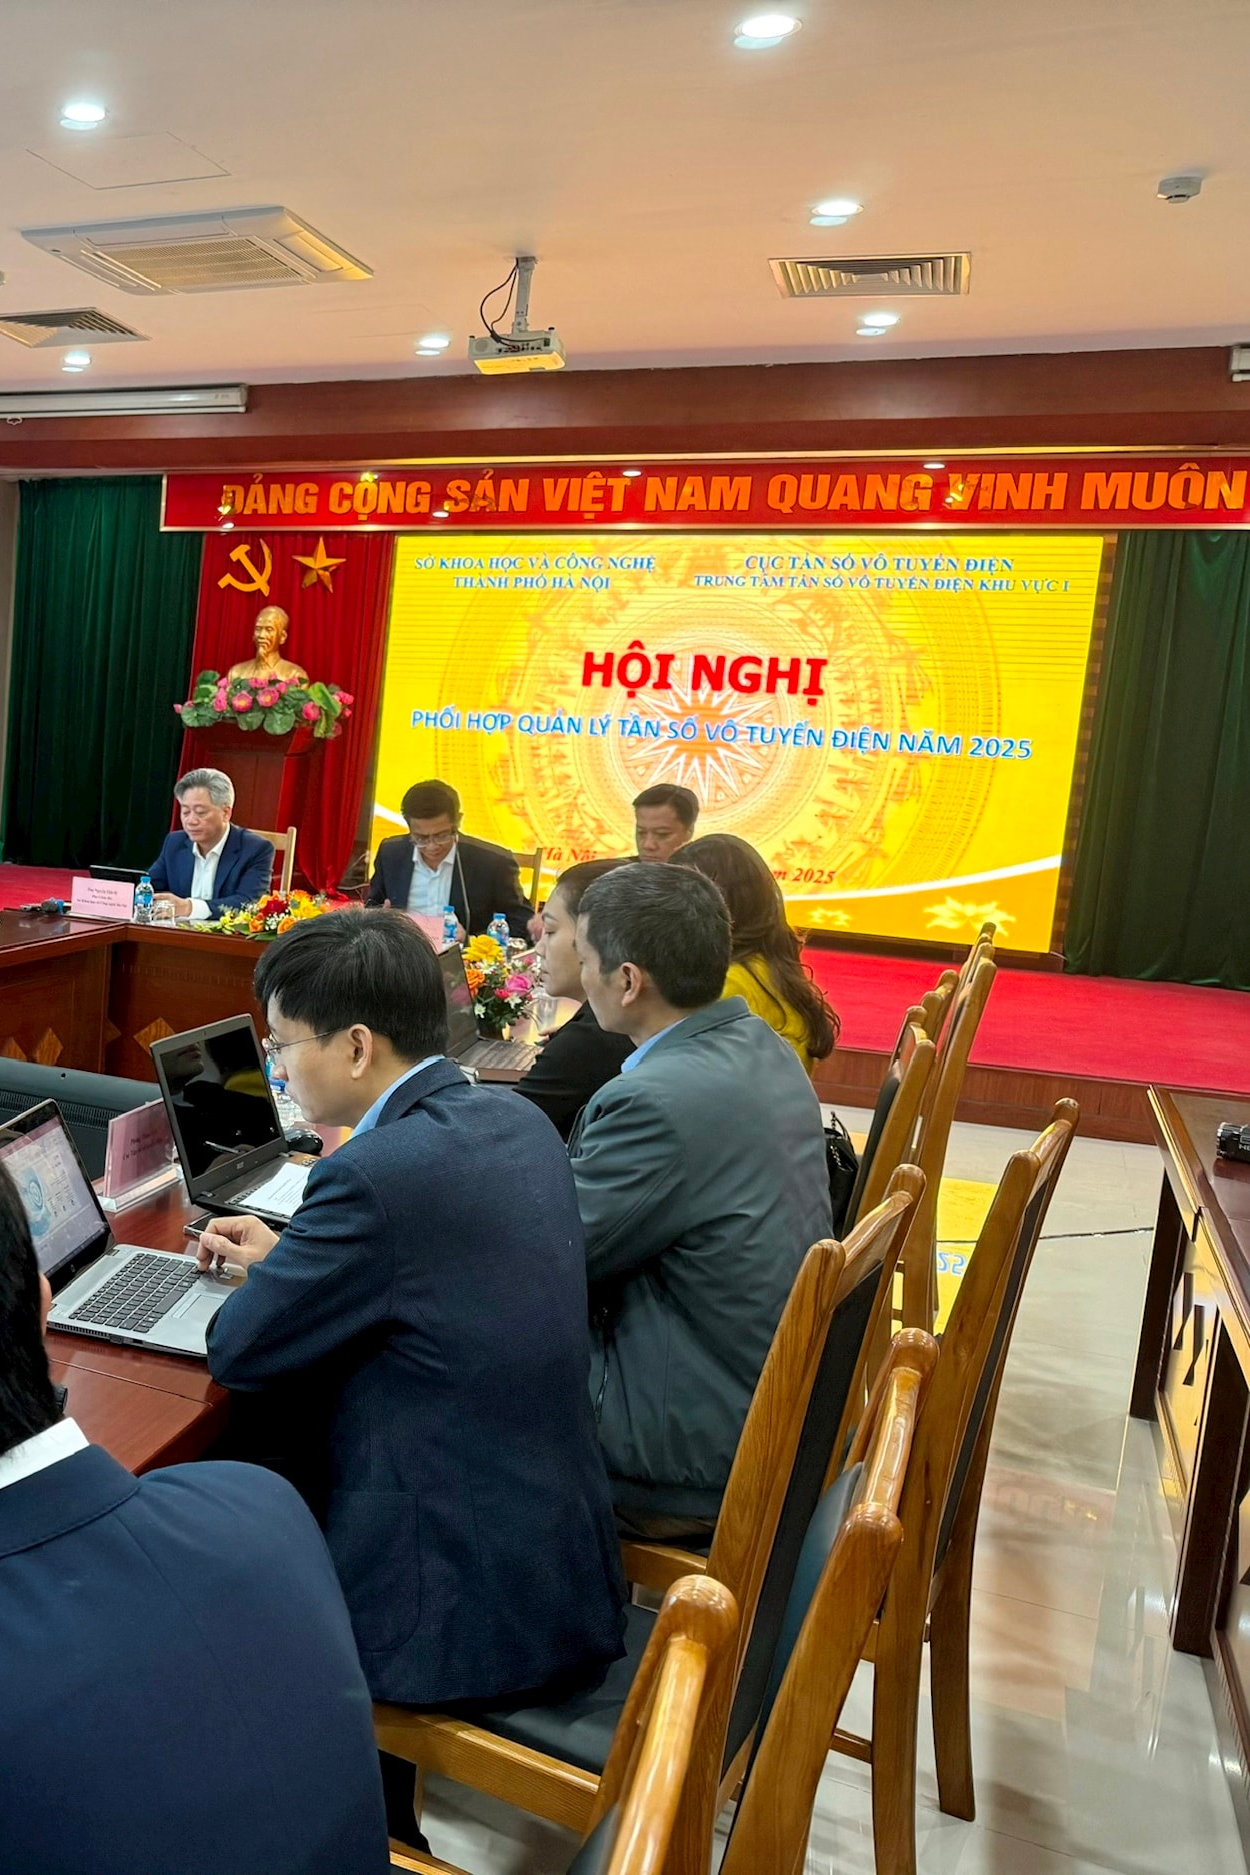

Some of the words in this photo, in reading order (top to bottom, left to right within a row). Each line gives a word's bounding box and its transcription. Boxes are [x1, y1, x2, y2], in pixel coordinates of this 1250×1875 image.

[221, 473, 319, 515] ĐẢNG
[329, 473, 431, 521] CỘNG
[447, 468, 529, 513] SẢN
[543, 471, 631, 519] VIỆT
[645, 475, 752, 512] NAM
[767, 473, 934, 514] QUANG
[948, 472, 1068, 511] VINH
[1080, 462, 1248, 511] MUÔN
[439, 557, 484, 570] KHOA
[488, 556, 524, 573] HỌC
[528, 552, 550, 570] VÀ
[555, 552, 603, 570] CÔNG
[745, 555, 784, 573] CỤC
[694, 574, 746, 587] TRUNG
[979, 579, 1017, 592] KHU
[582, 640, 675, 698] HỘI
[691, 654, 828, 706] NGHỊ
[411, 705, 461, 730] PHỐI
[467, 710, 513, 735] HỢP
[518, 708, 582, 737] QUẢN
[589, 711, 612, 737] LÝ
[618, 711, 661, 739] TẦN
[667, 714, 699, 741] SỐ
[705, 718, 738, 743] VÔ
[749, 720, 824, 748] TUYẾN
[831, 726, 890, 755] ĐIỆN
[899, 730, 961, 756] NĂM
[968, 736, 1033, 760] 2025
[792, 867, 836, 885] 2025
